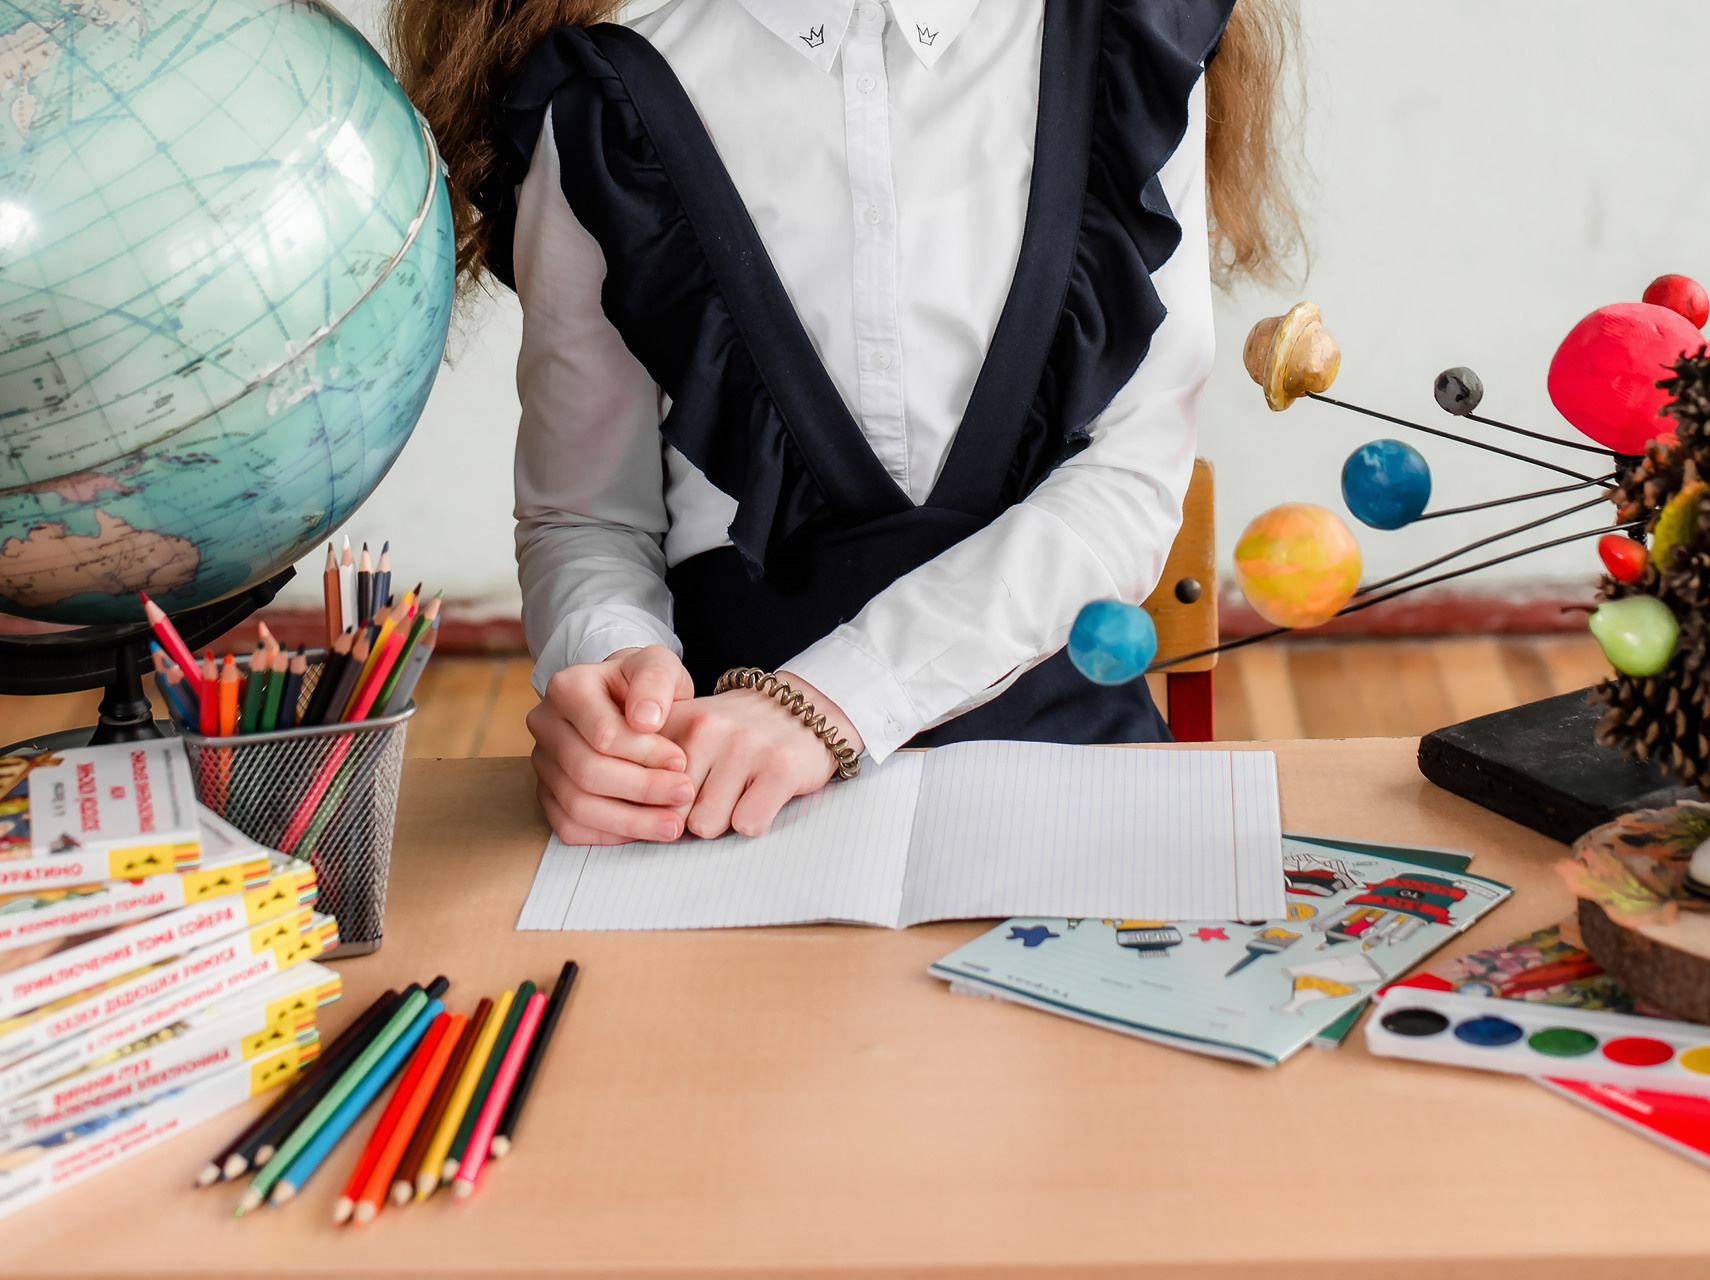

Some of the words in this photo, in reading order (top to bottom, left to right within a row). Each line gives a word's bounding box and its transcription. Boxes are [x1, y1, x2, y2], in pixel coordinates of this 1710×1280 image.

[12, 944, 133, 1000] ПРИКЛЮЧЕНИЯ
[136, 928, 175, 952] ТОМА
[178, 907, 235, 937] СОЙЕРА
[104, 972, 180, 1015] ДЯДЮШКИ
[183, 946, 236, 977] РИМУСА
